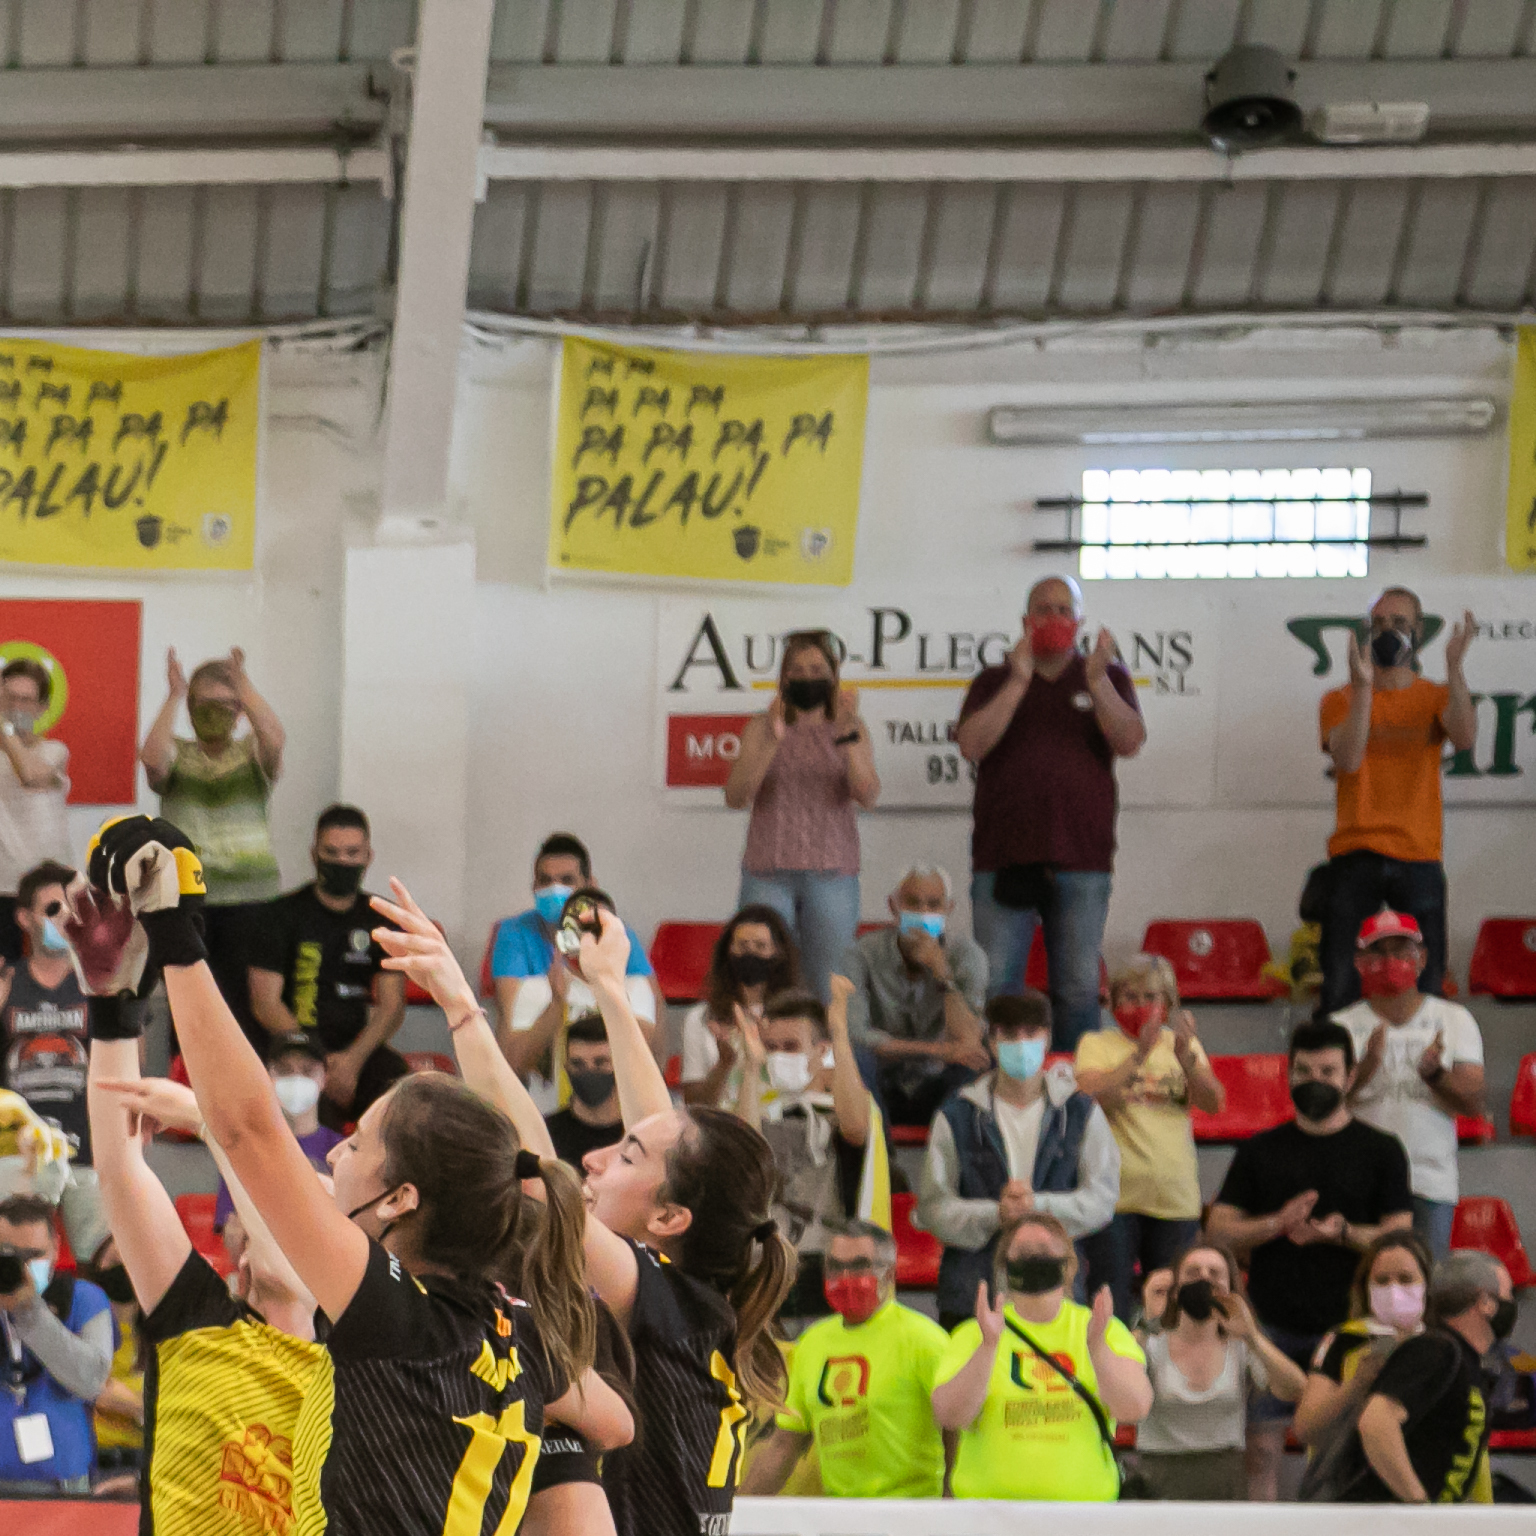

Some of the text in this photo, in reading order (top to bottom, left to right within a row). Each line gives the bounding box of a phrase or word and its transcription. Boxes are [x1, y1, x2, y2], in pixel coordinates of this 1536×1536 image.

[45, 414, 93, 459] PA
[112, 410, 163, 453] PA
[180, 397, 229, 448] PA
[572, 408, 834, 472] PA PA PA PA
[563, 451, 771, 536] PALAU!
